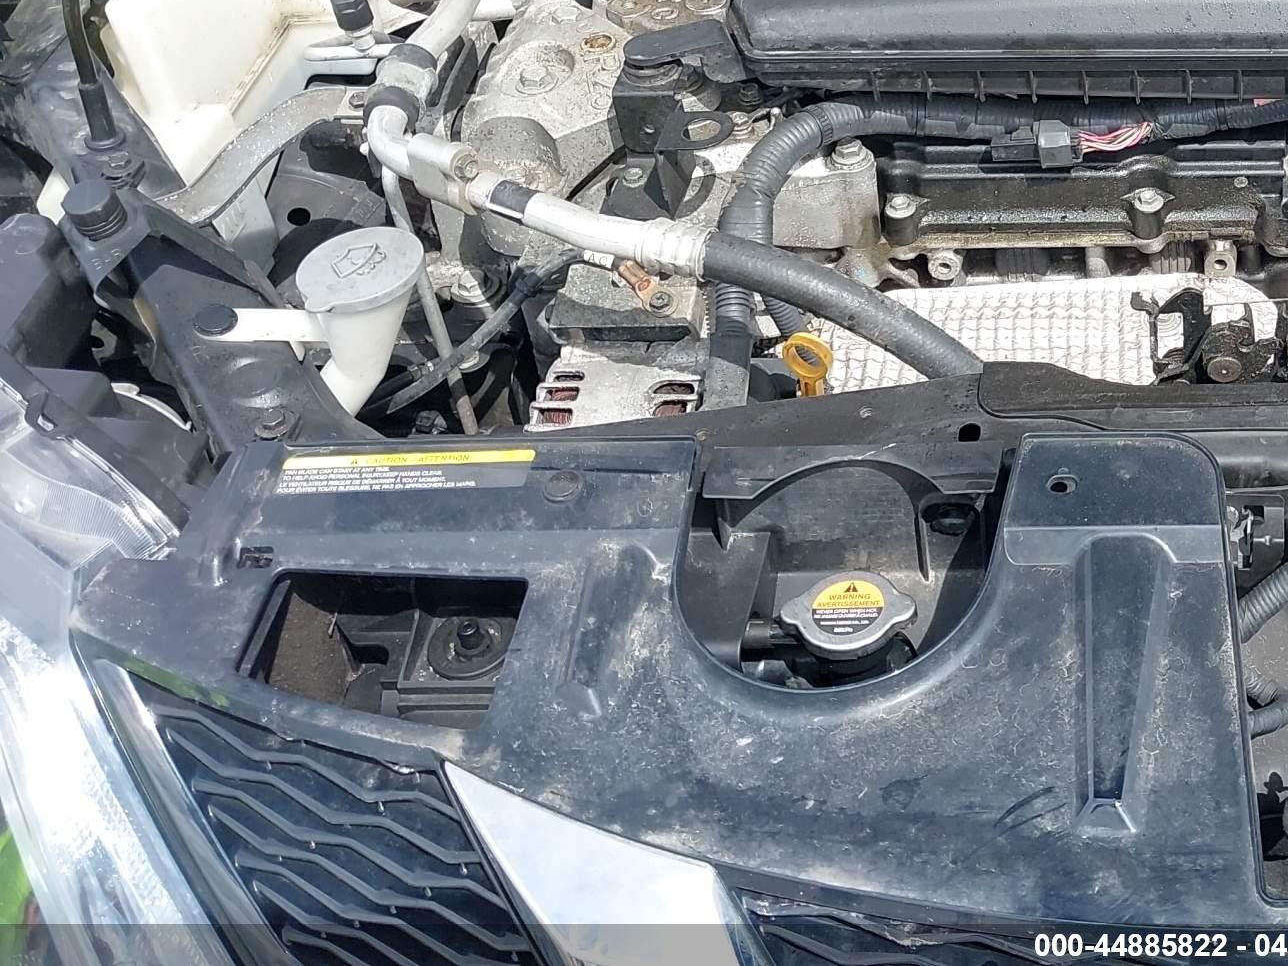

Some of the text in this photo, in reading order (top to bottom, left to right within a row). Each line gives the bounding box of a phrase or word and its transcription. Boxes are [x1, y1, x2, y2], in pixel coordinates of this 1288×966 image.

[366, 454, 470, 466] CAUTION ATTENTION
[815, 600, 880, 608] AVERTISSEMENT
